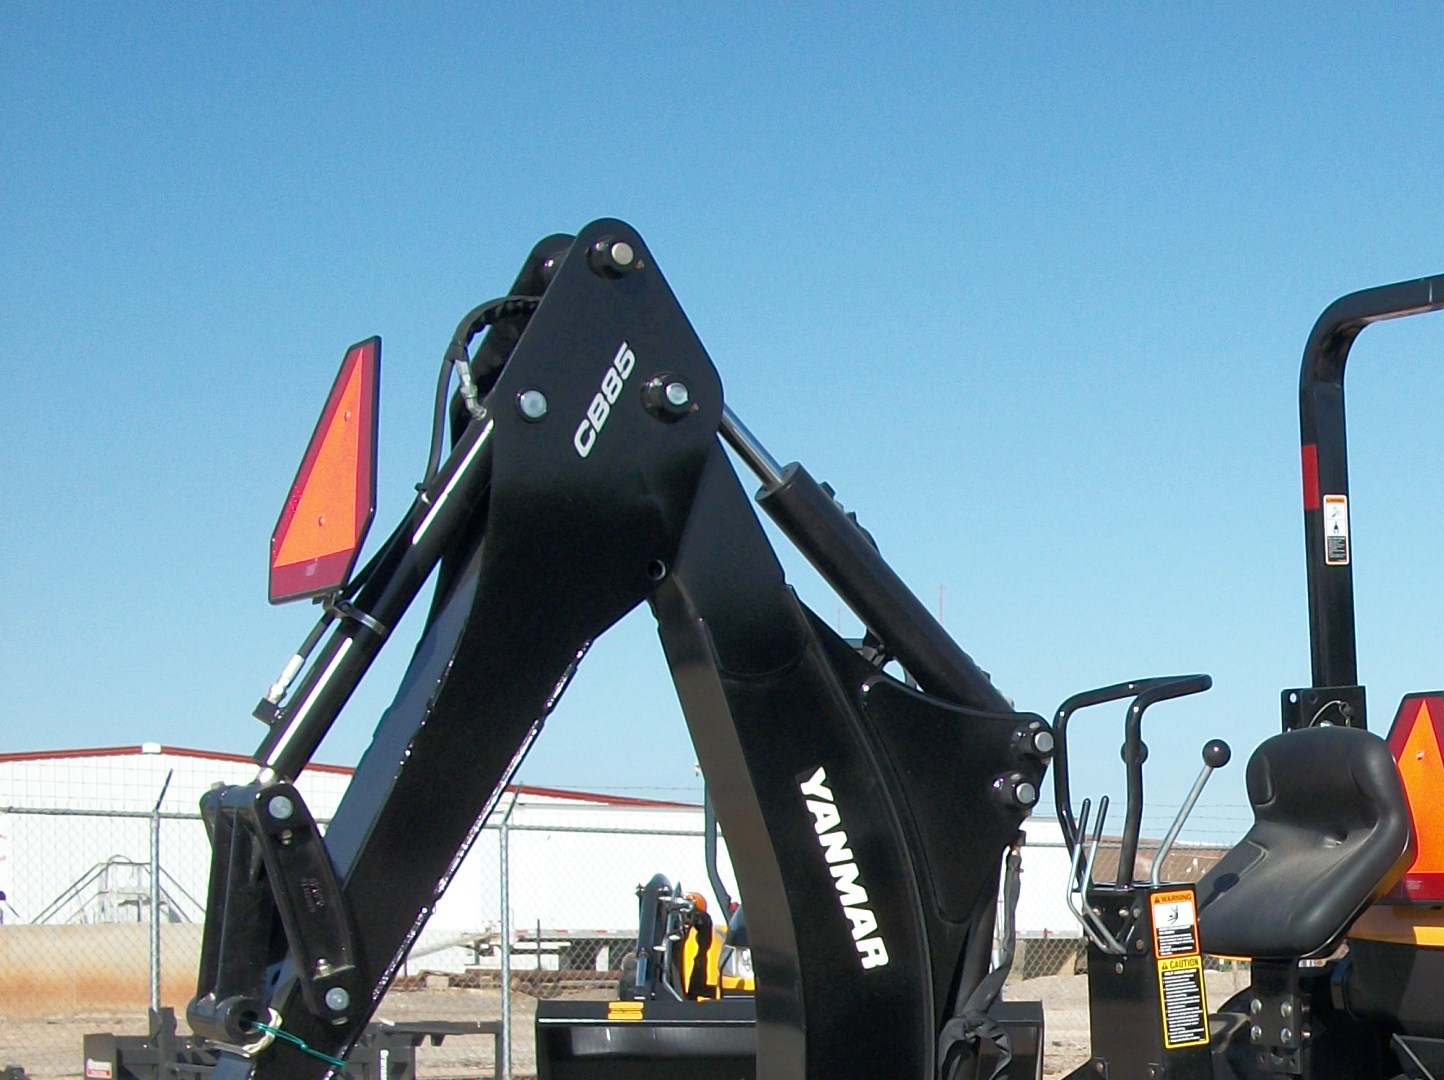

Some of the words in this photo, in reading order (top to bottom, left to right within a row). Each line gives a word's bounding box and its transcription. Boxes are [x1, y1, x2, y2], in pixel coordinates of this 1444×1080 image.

[574, 341, 636, 458] CB85
[800, 766, 889, 970] YANMAR
[1170, 958, 1199, 969] CAUTION
